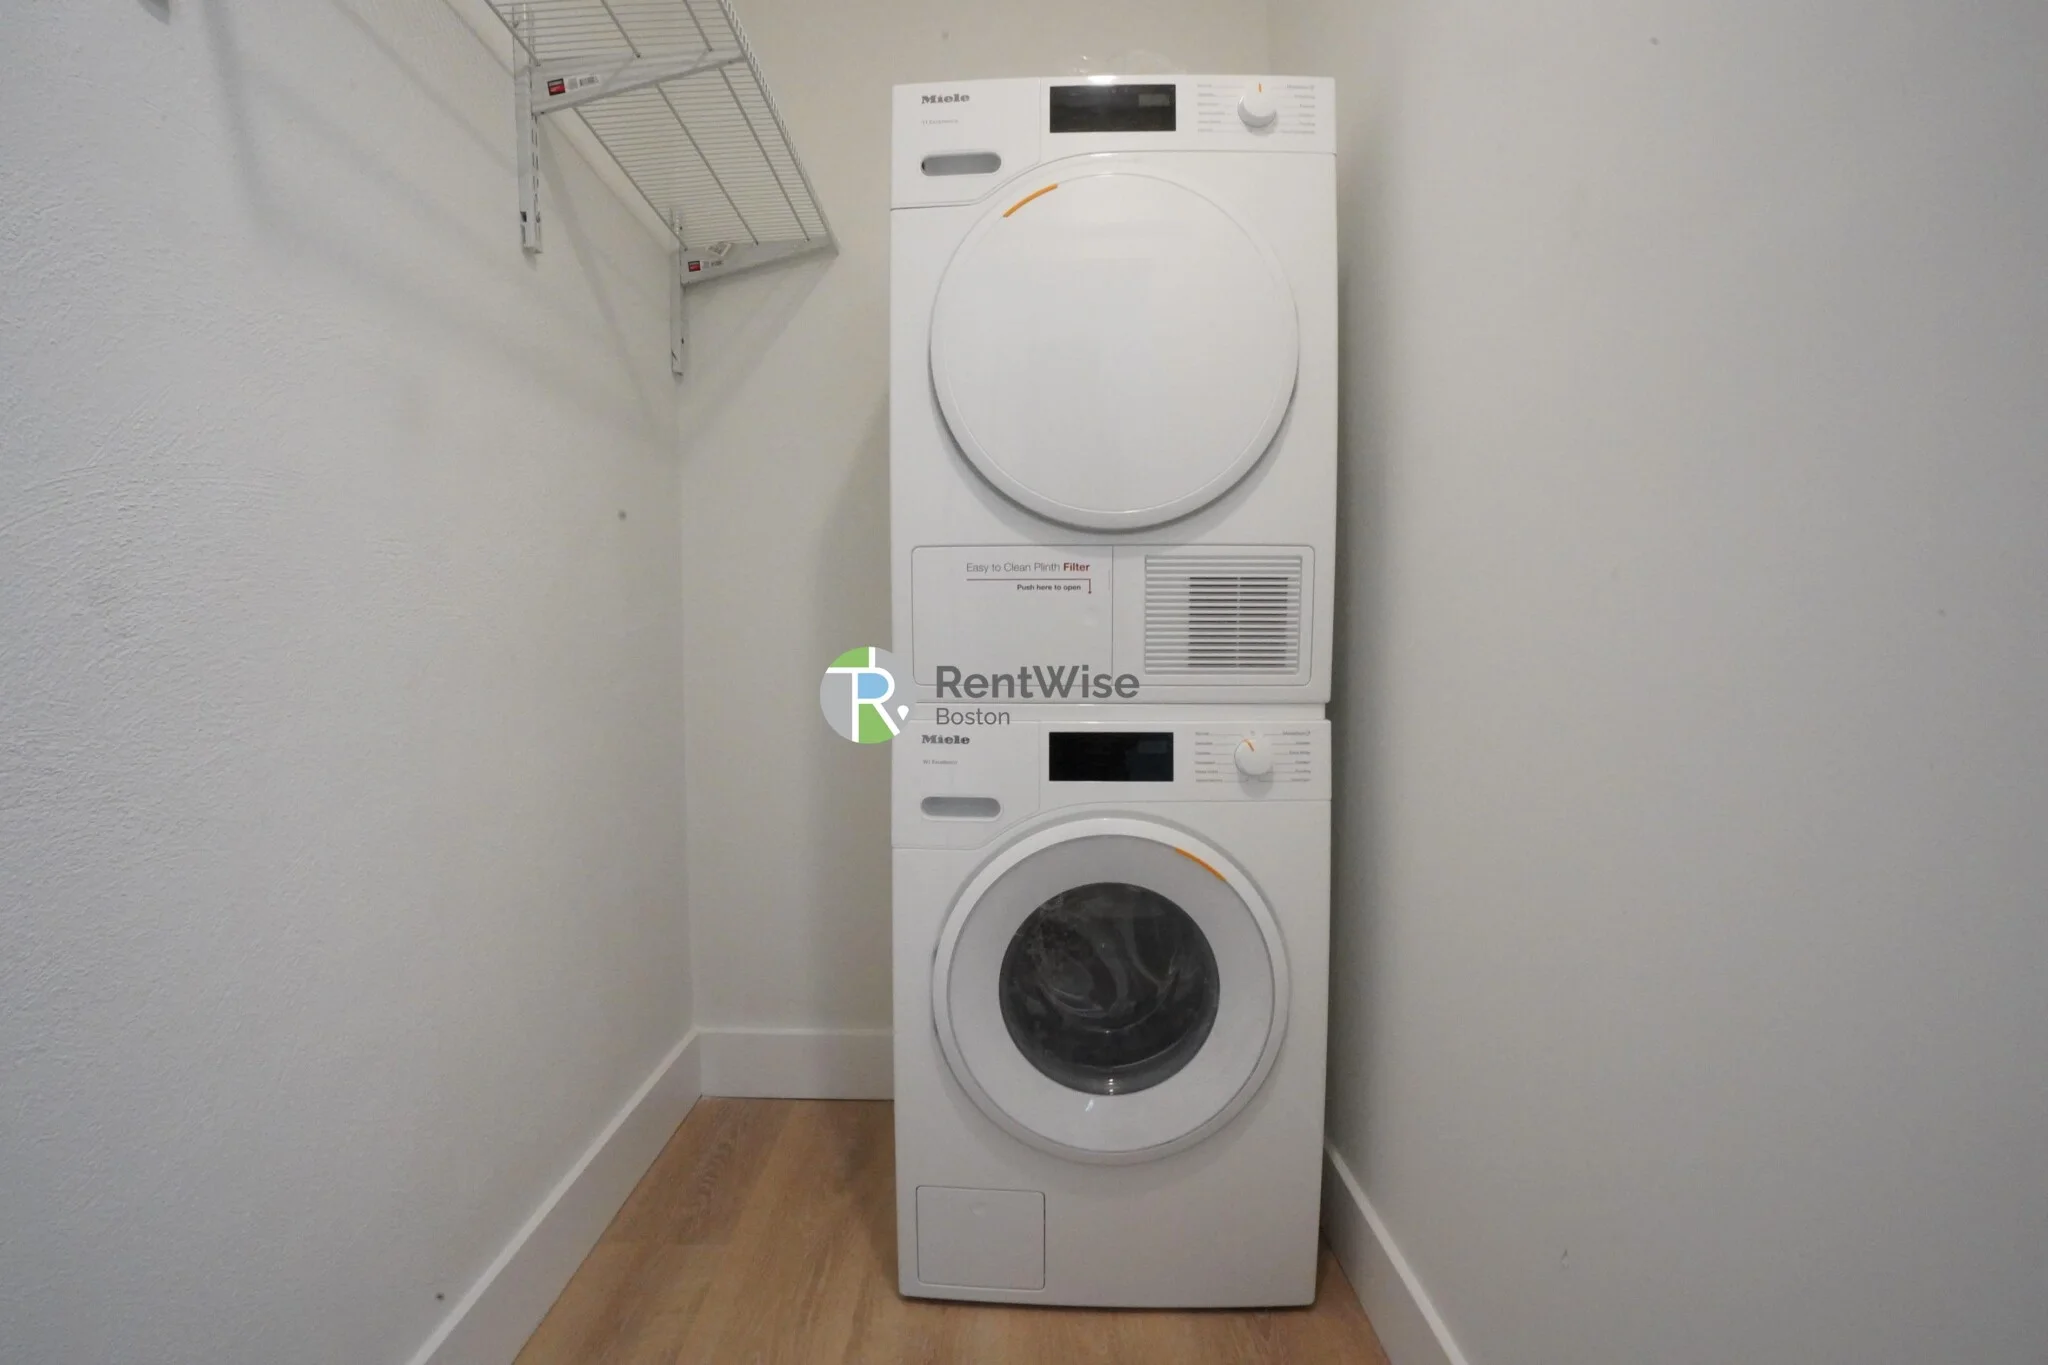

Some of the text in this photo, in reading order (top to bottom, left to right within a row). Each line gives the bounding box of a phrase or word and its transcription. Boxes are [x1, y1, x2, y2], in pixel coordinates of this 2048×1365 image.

[921, 93, 970, 104] Miele
[966, 562, 1091, 574] Easy to Clean Plinth Filter
[921, 734, 971, 745] Miele
